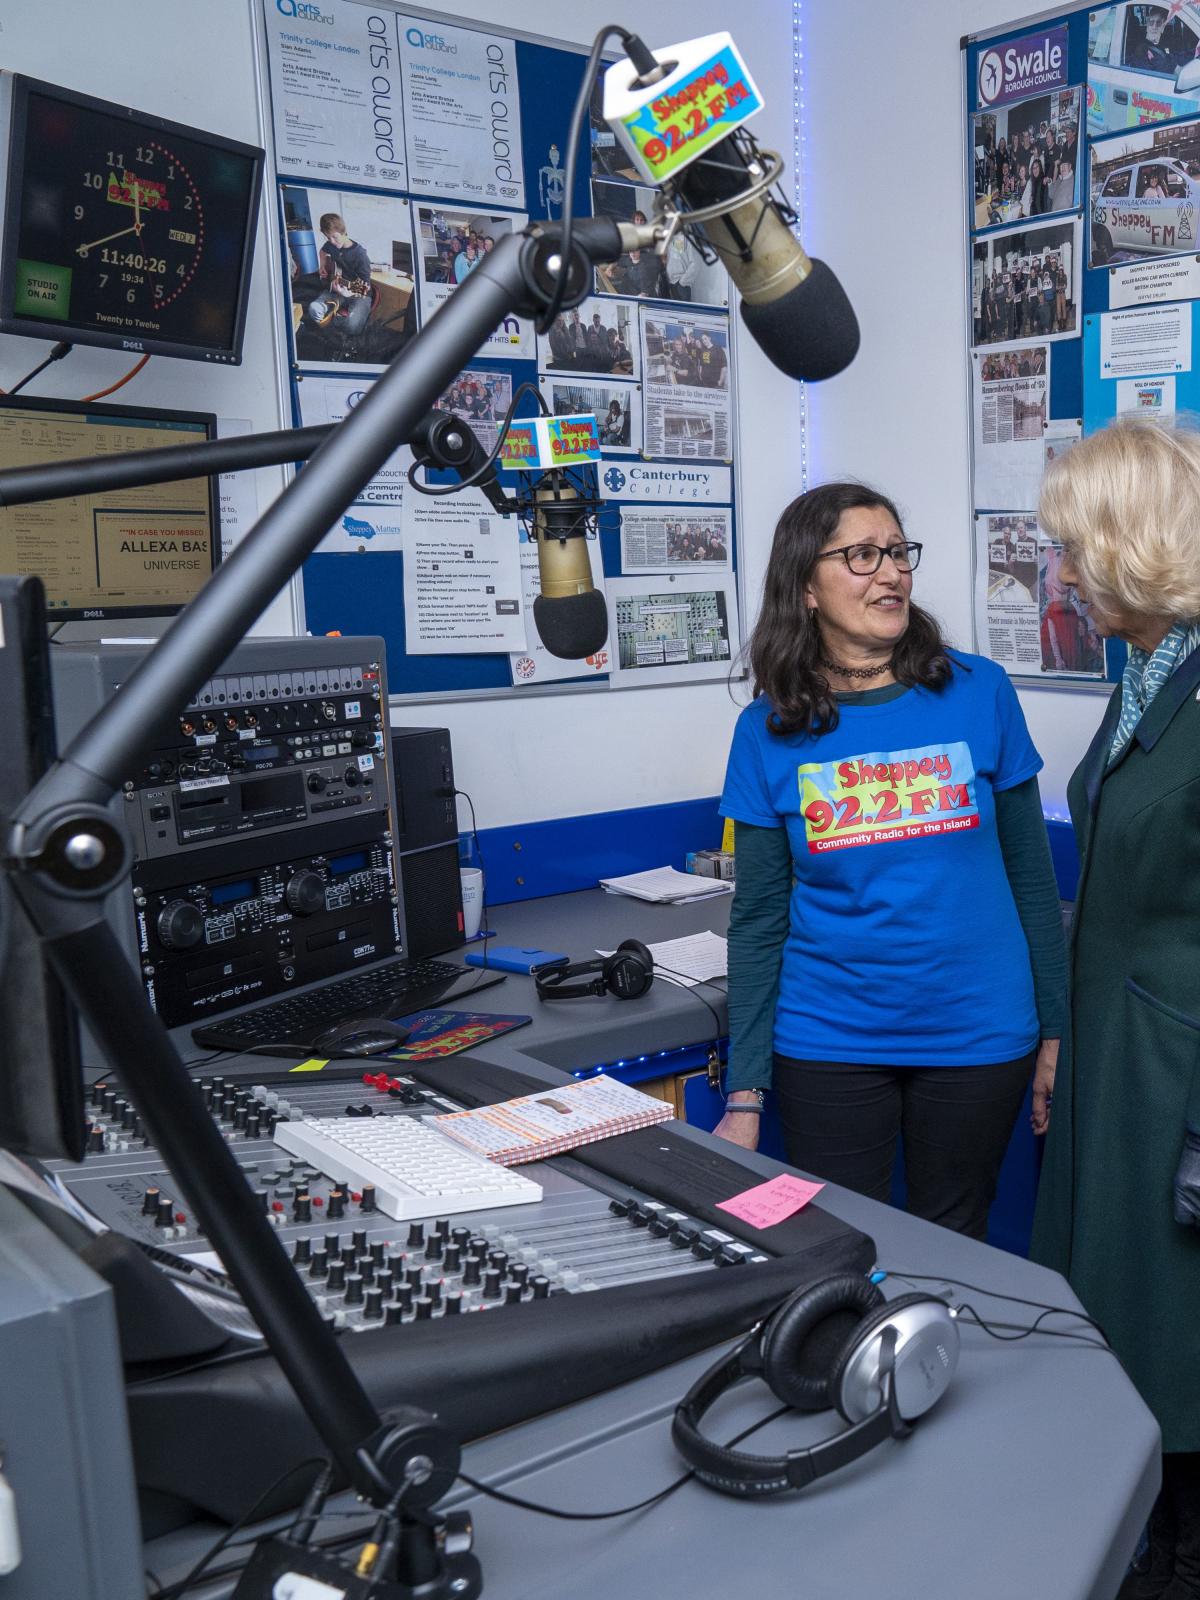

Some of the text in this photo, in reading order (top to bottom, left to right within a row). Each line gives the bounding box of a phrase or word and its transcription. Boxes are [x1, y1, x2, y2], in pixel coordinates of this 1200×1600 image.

[280, 32, 303, 44] Trinity
[305, 38, 332, 49] College
[334, 44, 360, 55] London
[1004, 38, 1062, 81] Swale
[409, 62, 430, 73] Trinity
[432, 67, 455, 77] College
[1004, 70, 1062, 93] BOROUGH COUNCIL
[368, 16, 403, 165] arts award
[652, 62, 729, 122] Sheppey
[486, 44, 522, 184] arts award
[642, 80, 753, 166] 92.2 FM
[106, 152, 125, 169] 11
[136, 147, 154, 165] 12
[83, 172, 103, 189] 10
[168, 166, 175, 180] 1
[184, 196, 193, 210] 2
[74, 206, 84, 220] 9
[1112, 208, 1152, 233] Sheppey
[1151, 226, 1176, 246] FM
[101, 248, 167, 274] 11:40:26
[122, 273, 144, 285] 19:34
[176, 264, 185, 278] 4
[27, 279, 59, 291] STUDIO
[100, 274, 109, 288] 7
[28, 290, 57, 301] ON AIR
[127, 289, 136, 303] 6
[154, 285, 164, 299] 5
[96, 312, 160, 330] Twenty to Twelve
[630, 468, 710, 485] Canterbury
[376, 525, 400, 533] Matters
[120, 541, 178, 552] ALLEXA
[144, 560, 201, 570] UNIVERSE
[838, 754, 952, 789] Sheppey
[805, 784, 974, 834] 92.2 FM
[816, 818, 971, 850] Community Radio for the Island
[138, 912, 149, 953] Numark
